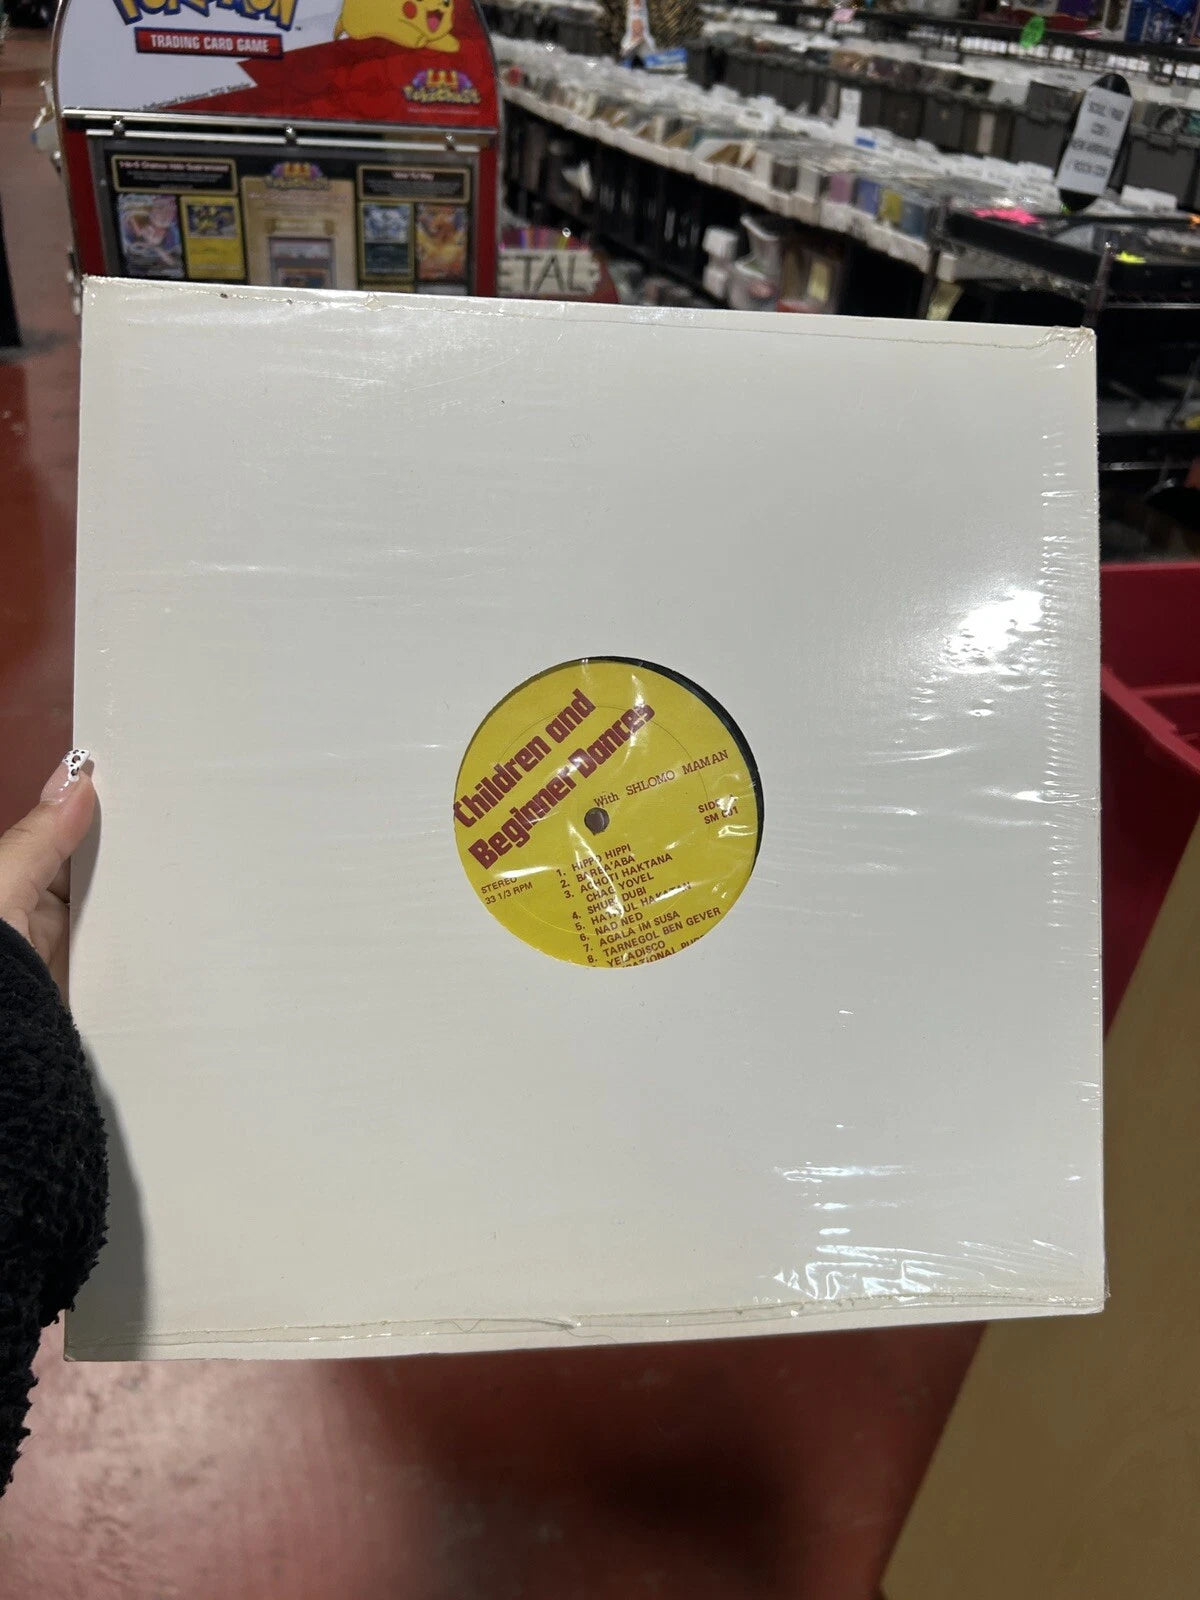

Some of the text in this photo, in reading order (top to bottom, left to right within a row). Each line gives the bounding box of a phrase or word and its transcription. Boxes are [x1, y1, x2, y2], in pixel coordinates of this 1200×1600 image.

[150, 34, 270, 53] TRADING CARD GAME
[453, 687, 597, 828] Children and
[468, 704, 656, 870] Beginner Dances
[593, 749, 729, 807] With SHLOMO MAMAN
[704, 812, 719, 824] SM
[556, 843, 631, 877] 1. HIPPO HIPPI
[564, 853, 673, 899] 3. ACHOTI HAKTANA
[481, 876, 517, 894] STEREO
[485, 881, 533, 905] 33 1/3 RPM
[560, 879, 570, 888] 2.
[618, 872, 655, 890] YOVEL
[572, 911, 582, 920] 4.
[621, 886, 647, 902] DUBI
[575, 922, 586, 931] 5.
[580, 911, 644, 942] 6. NAD NED
[583, 910, 681, 952] 7. AGALA IM SUSA
[587, 906, 721, 963] 8. TARNEGOL BEN GEVER
